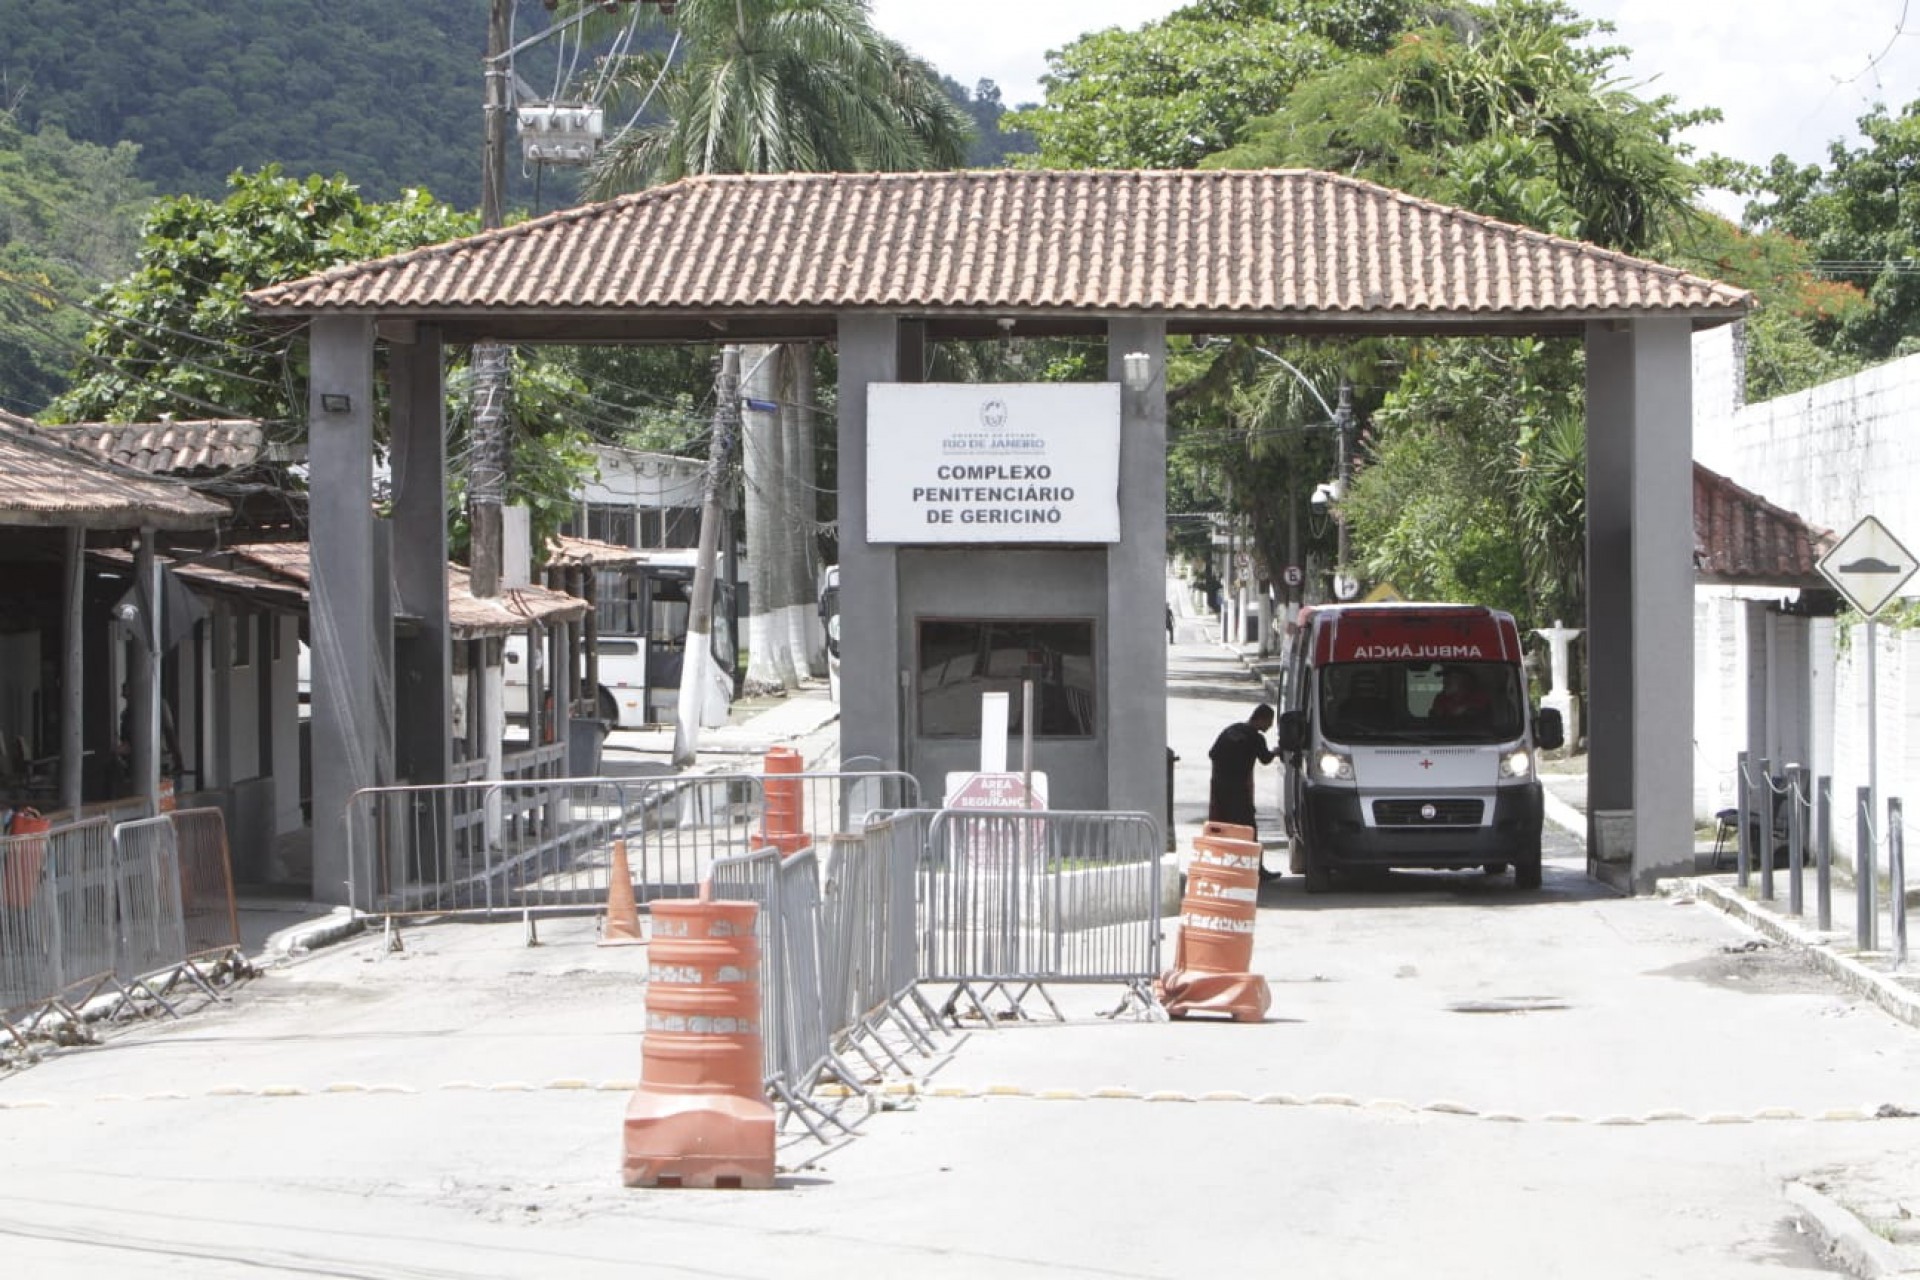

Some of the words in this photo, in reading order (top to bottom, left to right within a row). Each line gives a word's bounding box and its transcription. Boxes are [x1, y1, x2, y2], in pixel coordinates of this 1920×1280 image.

[942, 439, 967, 449] RIO
[969, 439, 986, 449] DE
[990, 439, 1045, 449] JANEIRO
[937, 465, 1051, 480] COMPLEXO
[912, 484, 1075, 502] PENITENCIÁRIO
[926, 509, 953, 524] DE
[960, 506, 1062, 524] GERICINÓ
